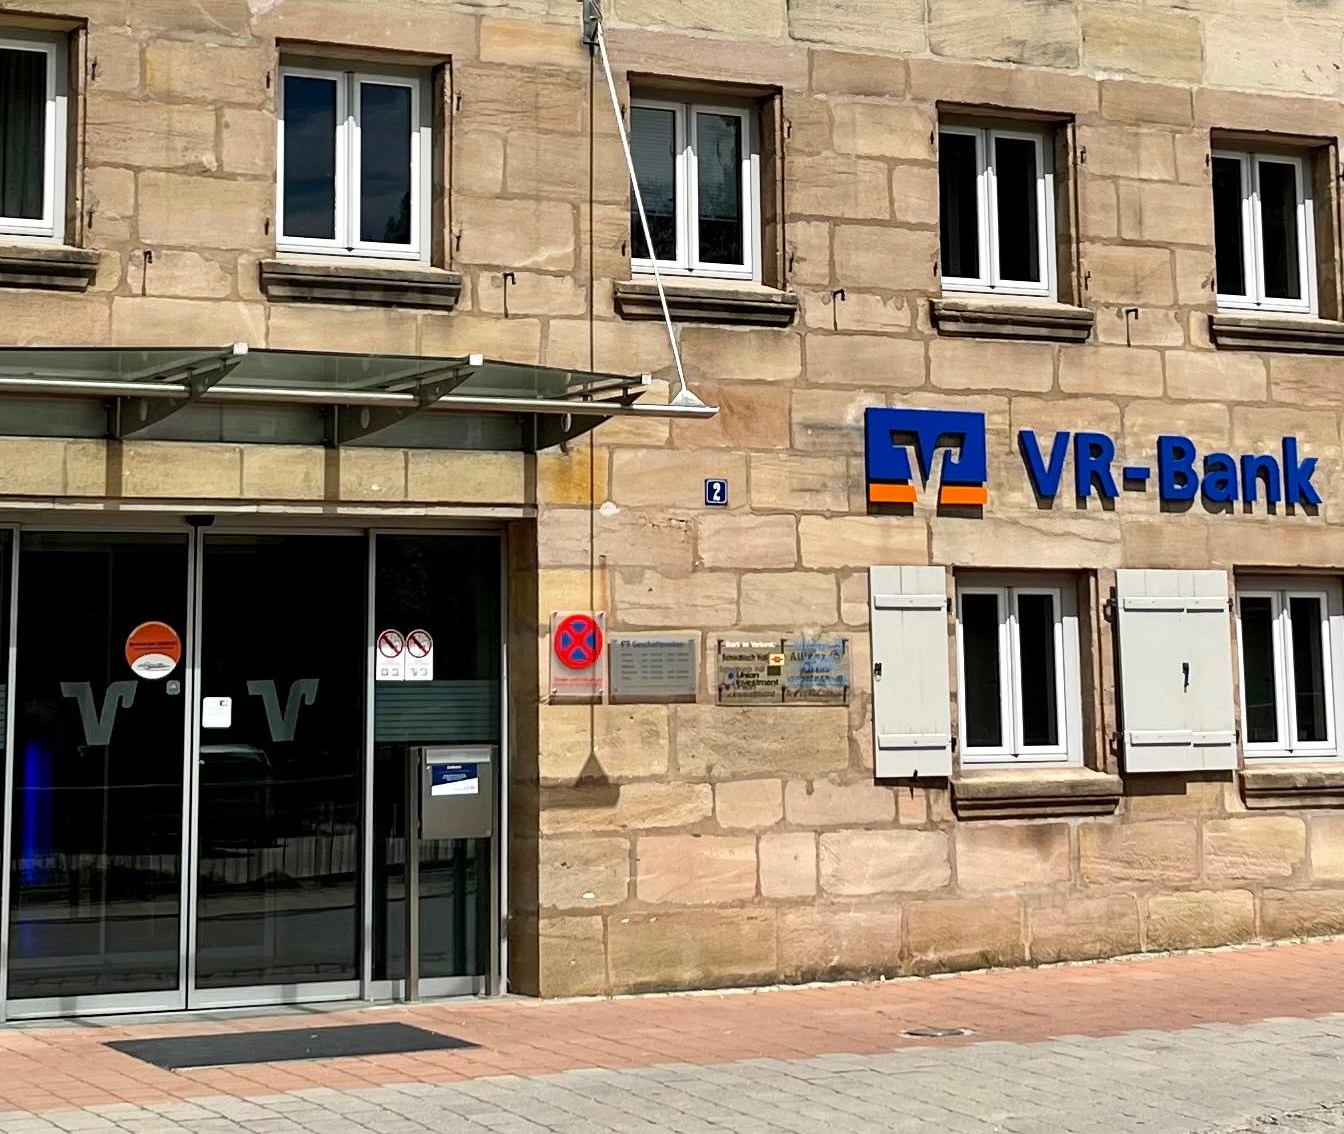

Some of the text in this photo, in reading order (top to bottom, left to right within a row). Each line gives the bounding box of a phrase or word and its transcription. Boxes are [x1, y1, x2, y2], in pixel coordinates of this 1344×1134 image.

[1018, 429, 1323, 506] VR-Bank
[712, 482, 721, 502] 2
[736, 671, 760, 679] Union
